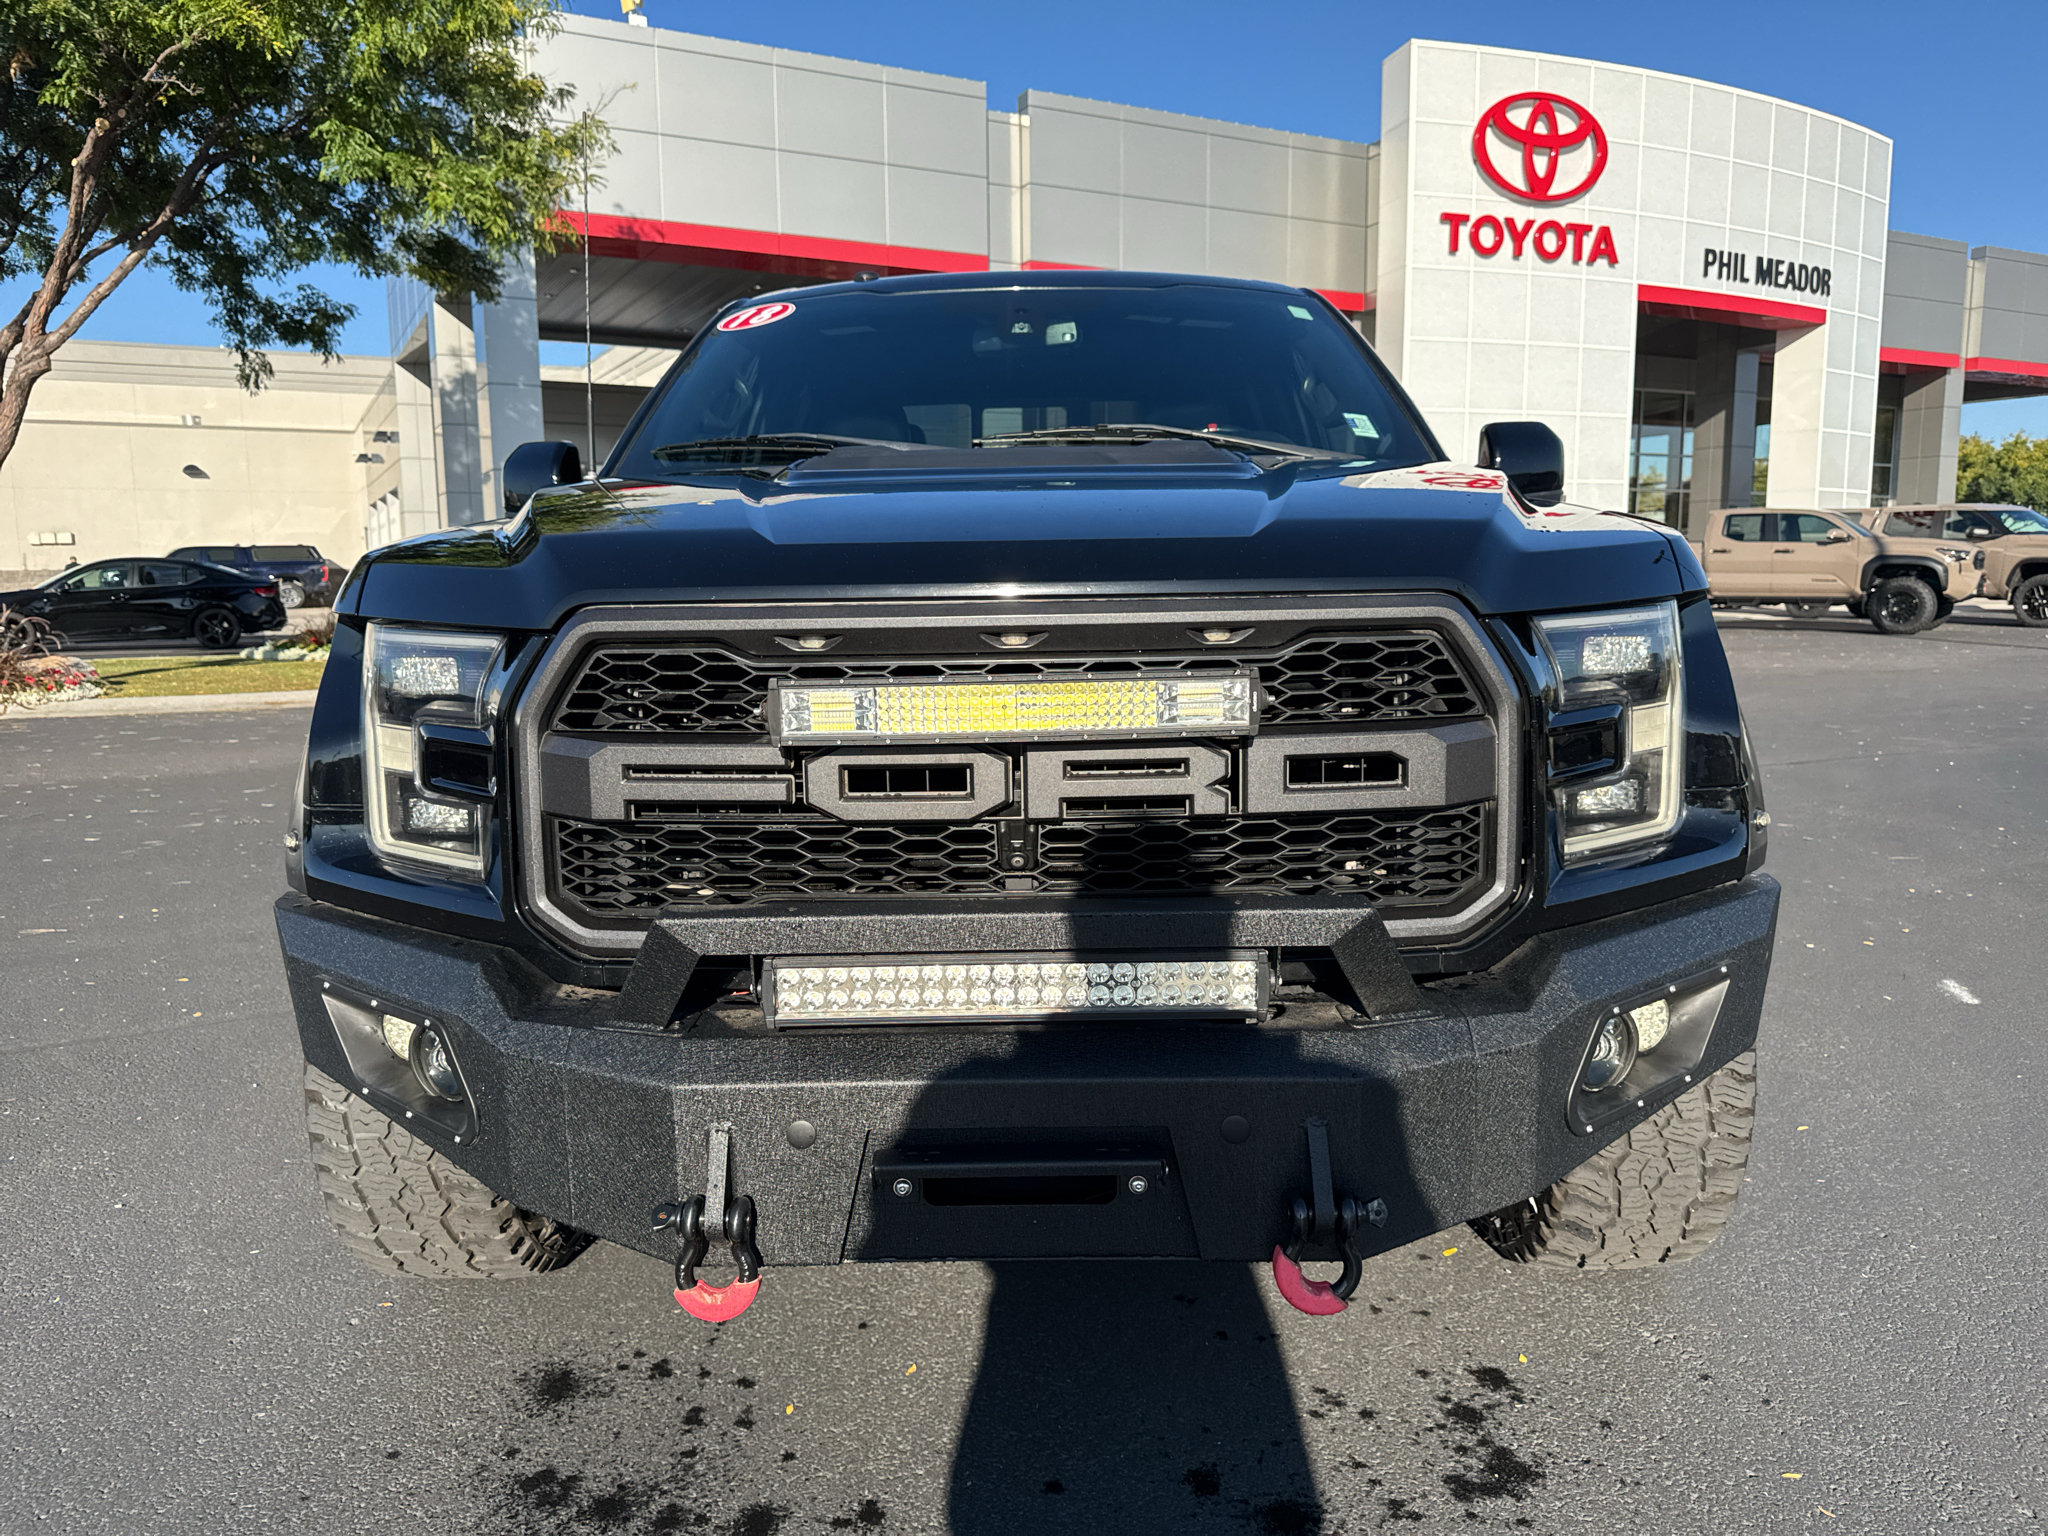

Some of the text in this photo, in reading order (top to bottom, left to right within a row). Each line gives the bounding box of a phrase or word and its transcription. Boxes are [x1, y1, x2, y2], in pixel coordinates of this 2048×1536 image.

[1440, 212, 1619, 266] TOYOTA
[1703, 248, 1832, 297] PHIL MEADOR
[727, 304, 783, 329] 18
[589, 731, 1448, 823] FORD
